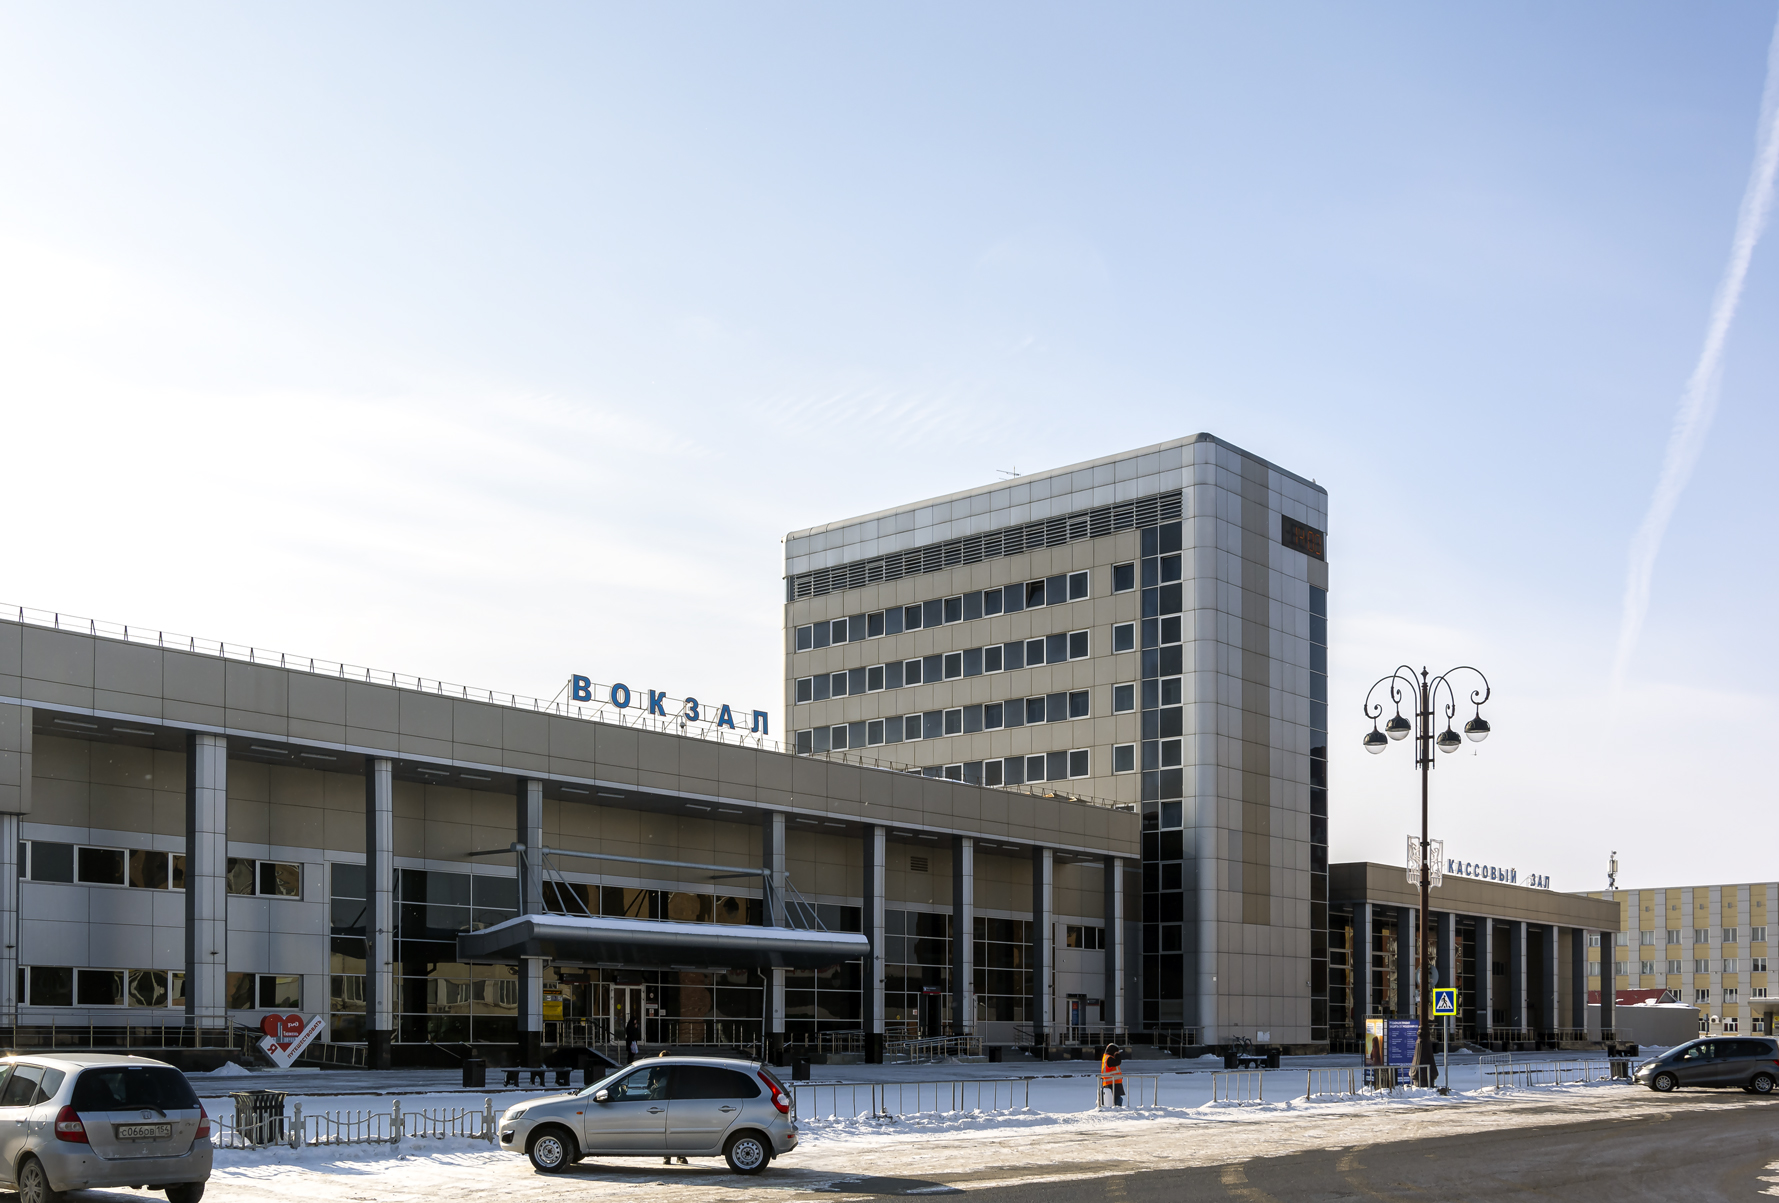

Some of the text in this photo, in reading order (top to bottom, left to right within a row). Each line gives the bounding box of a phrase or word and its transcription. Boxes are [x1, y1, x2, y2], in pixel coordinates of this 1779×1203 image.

[571, 674, 769, 735] ВОКЗАЛ
[1447, 858, 1550, 889] КАССОВЫЙ ЗАЛ
[267, 1043, 279, 1056] Я
